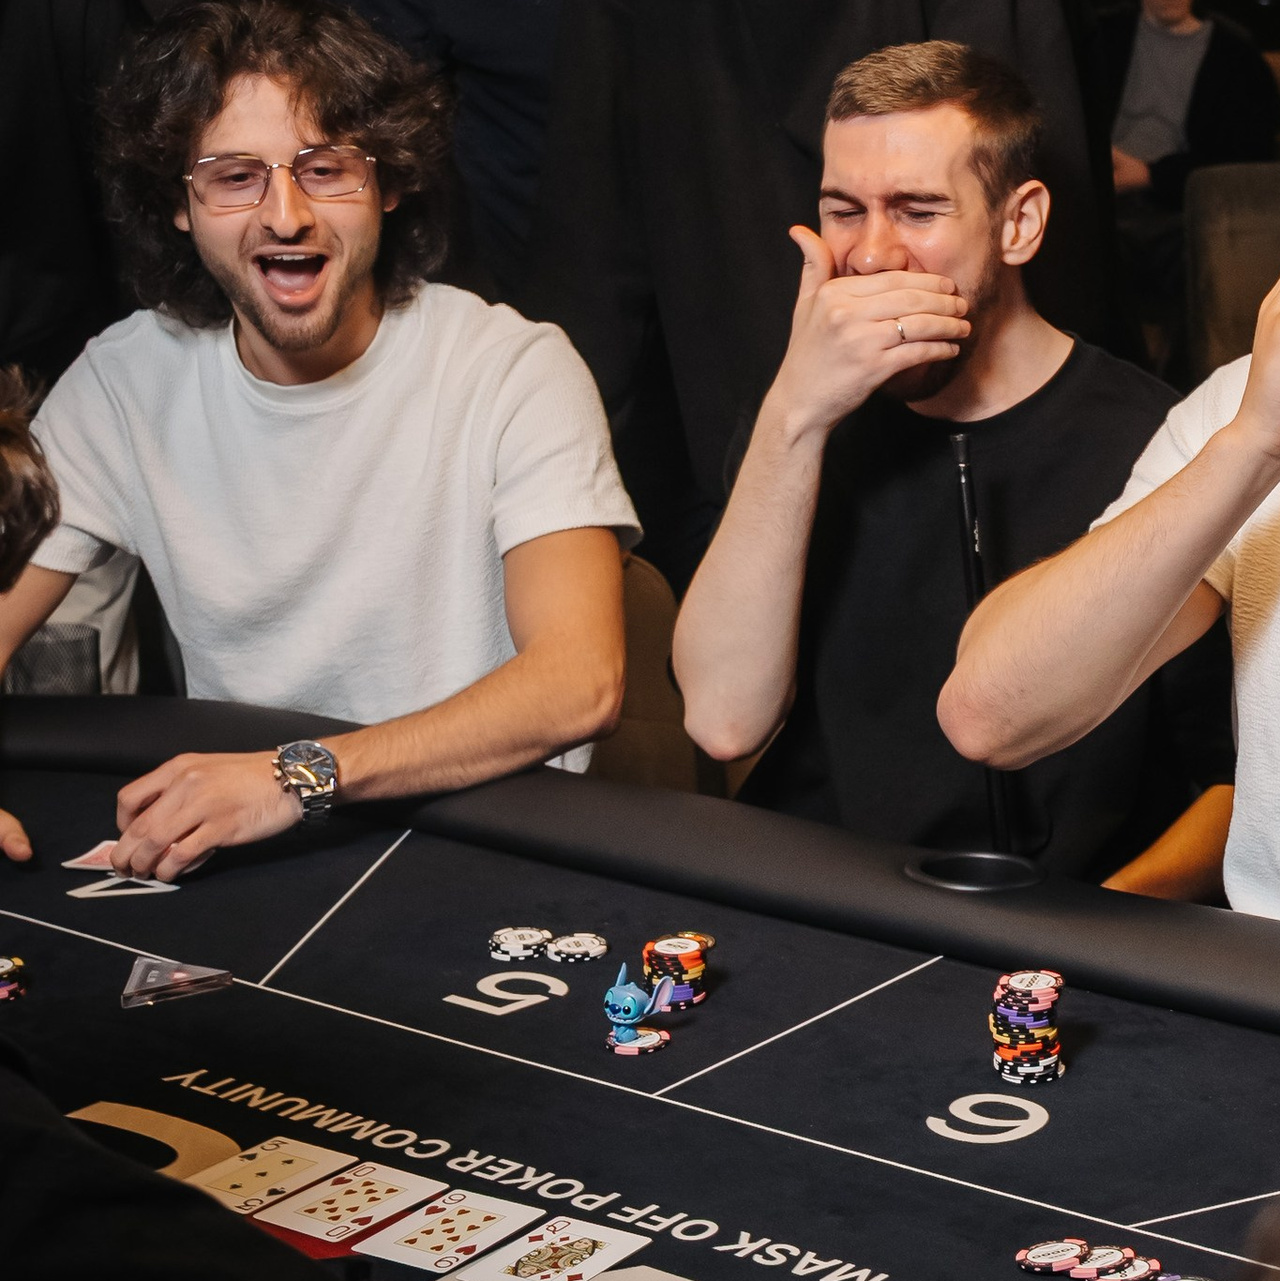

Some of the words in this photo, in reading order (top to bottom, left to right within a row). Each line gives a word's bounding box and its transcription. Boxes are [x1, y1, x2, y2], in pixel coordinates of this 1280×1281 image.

[441, 971, 570, 1017] 5
[162, 1069, 451, 1159] COMMUNITY
[348, 1163, 377, 1178] 10
[446, 1149, 622, 1211] POKER
[325, 1225, 357, 1240] 10
[545, 1220, 572, 1235] Q
[606, 1203, 719, 1241] OFF
